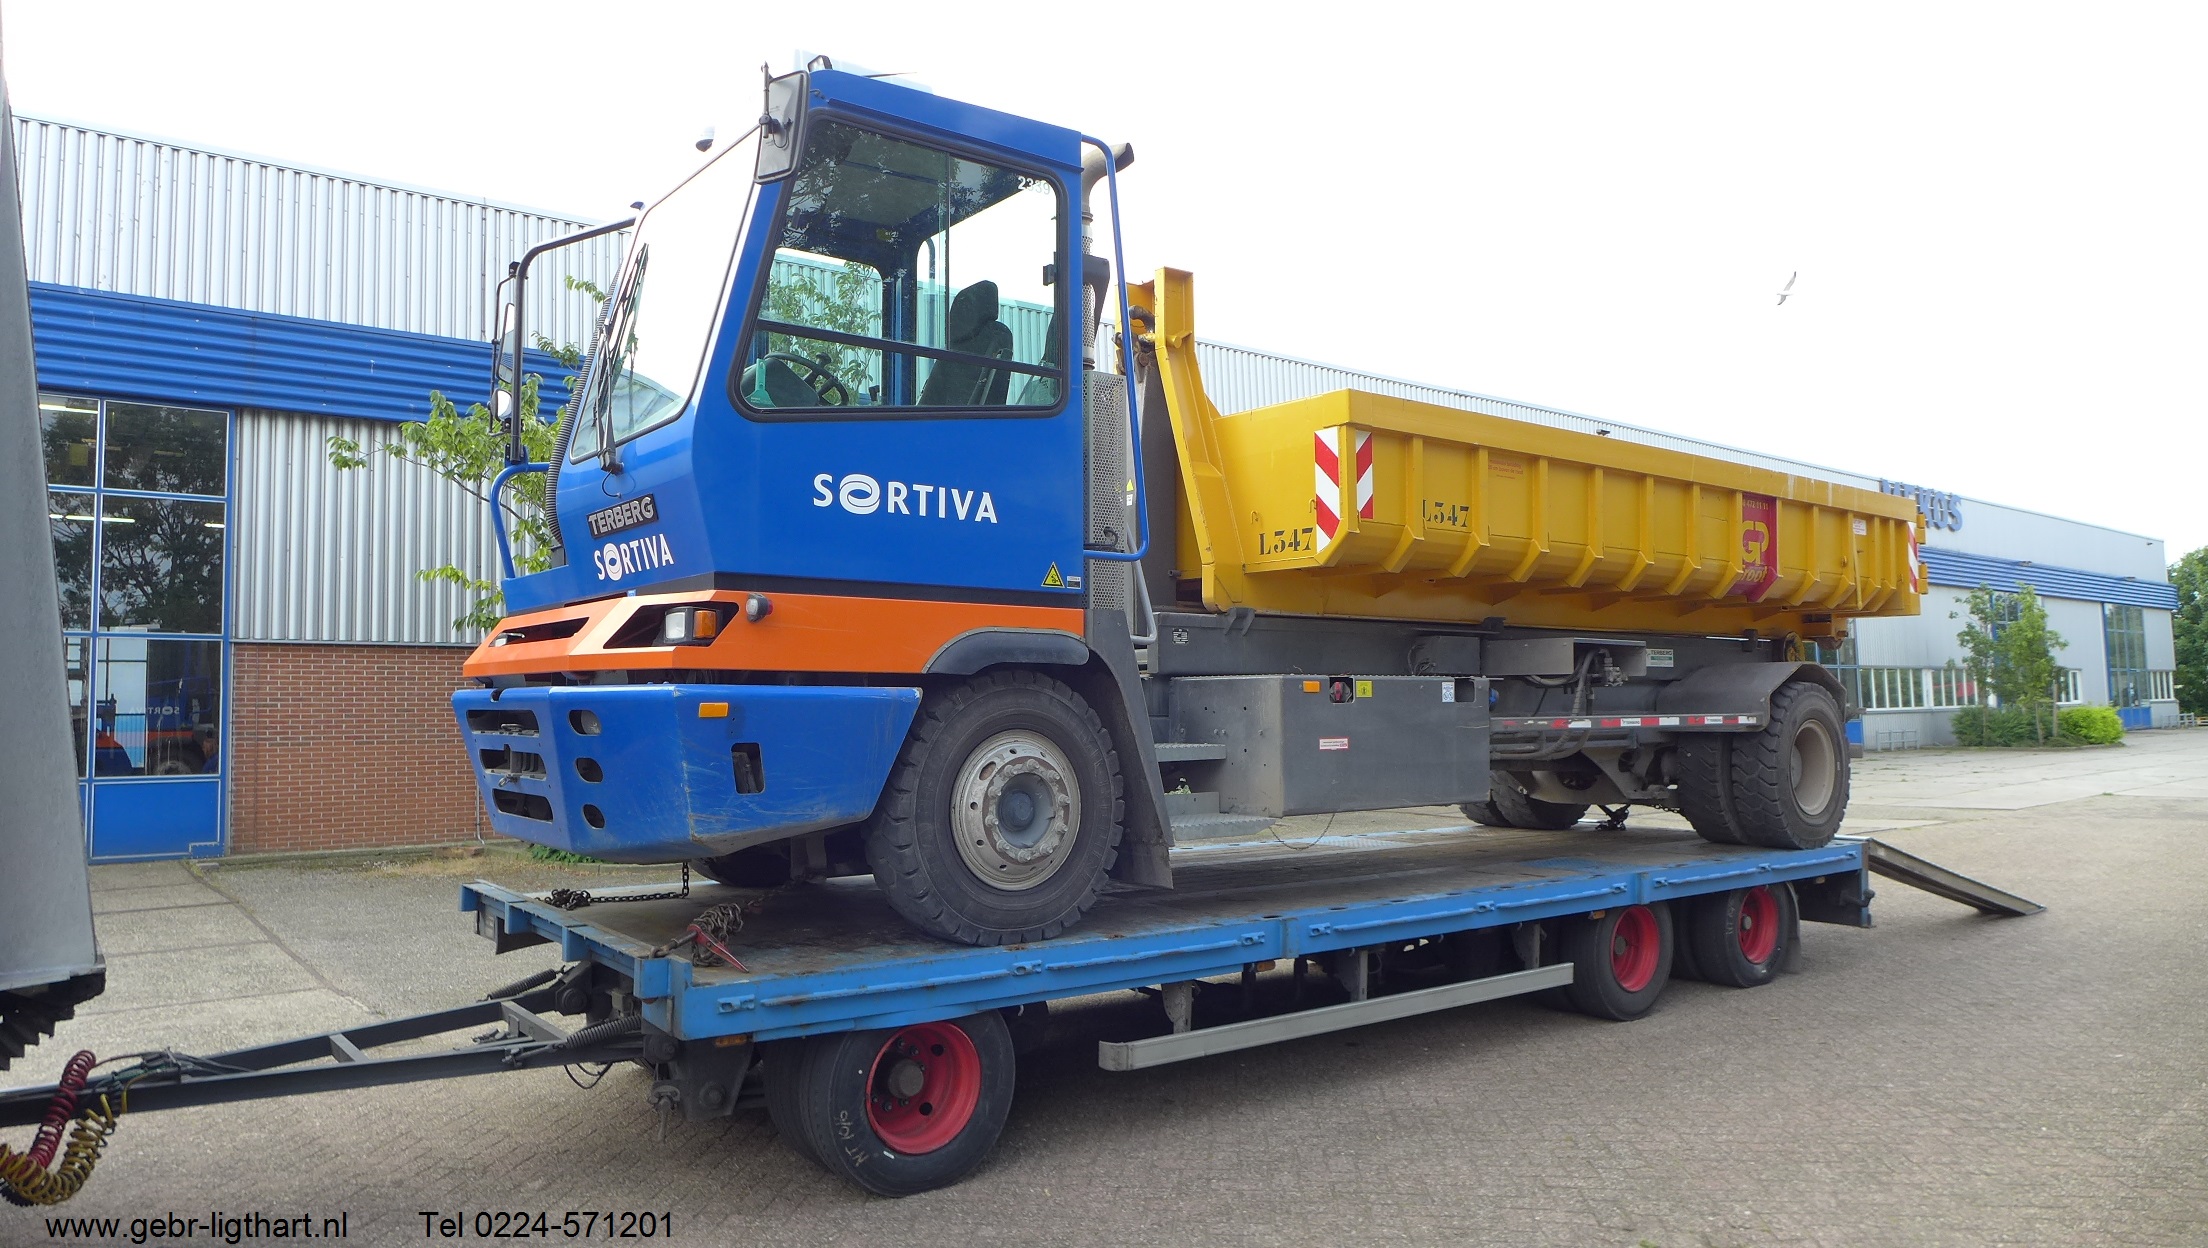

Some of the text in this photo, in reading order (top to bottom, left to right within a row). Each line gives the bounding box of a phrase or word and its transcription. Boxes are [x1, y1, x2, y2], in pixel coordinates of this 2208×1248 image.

[813, 473, 998, 524] SORTIVA
[1423, 499, 1469, 528] L347
[587, 496, 655, 536] TERBERG
[594, 533, 674, 581] SORTIVA
[1259, 527, 1313, 555] L347
[1738, 565, 1768, 582] root
